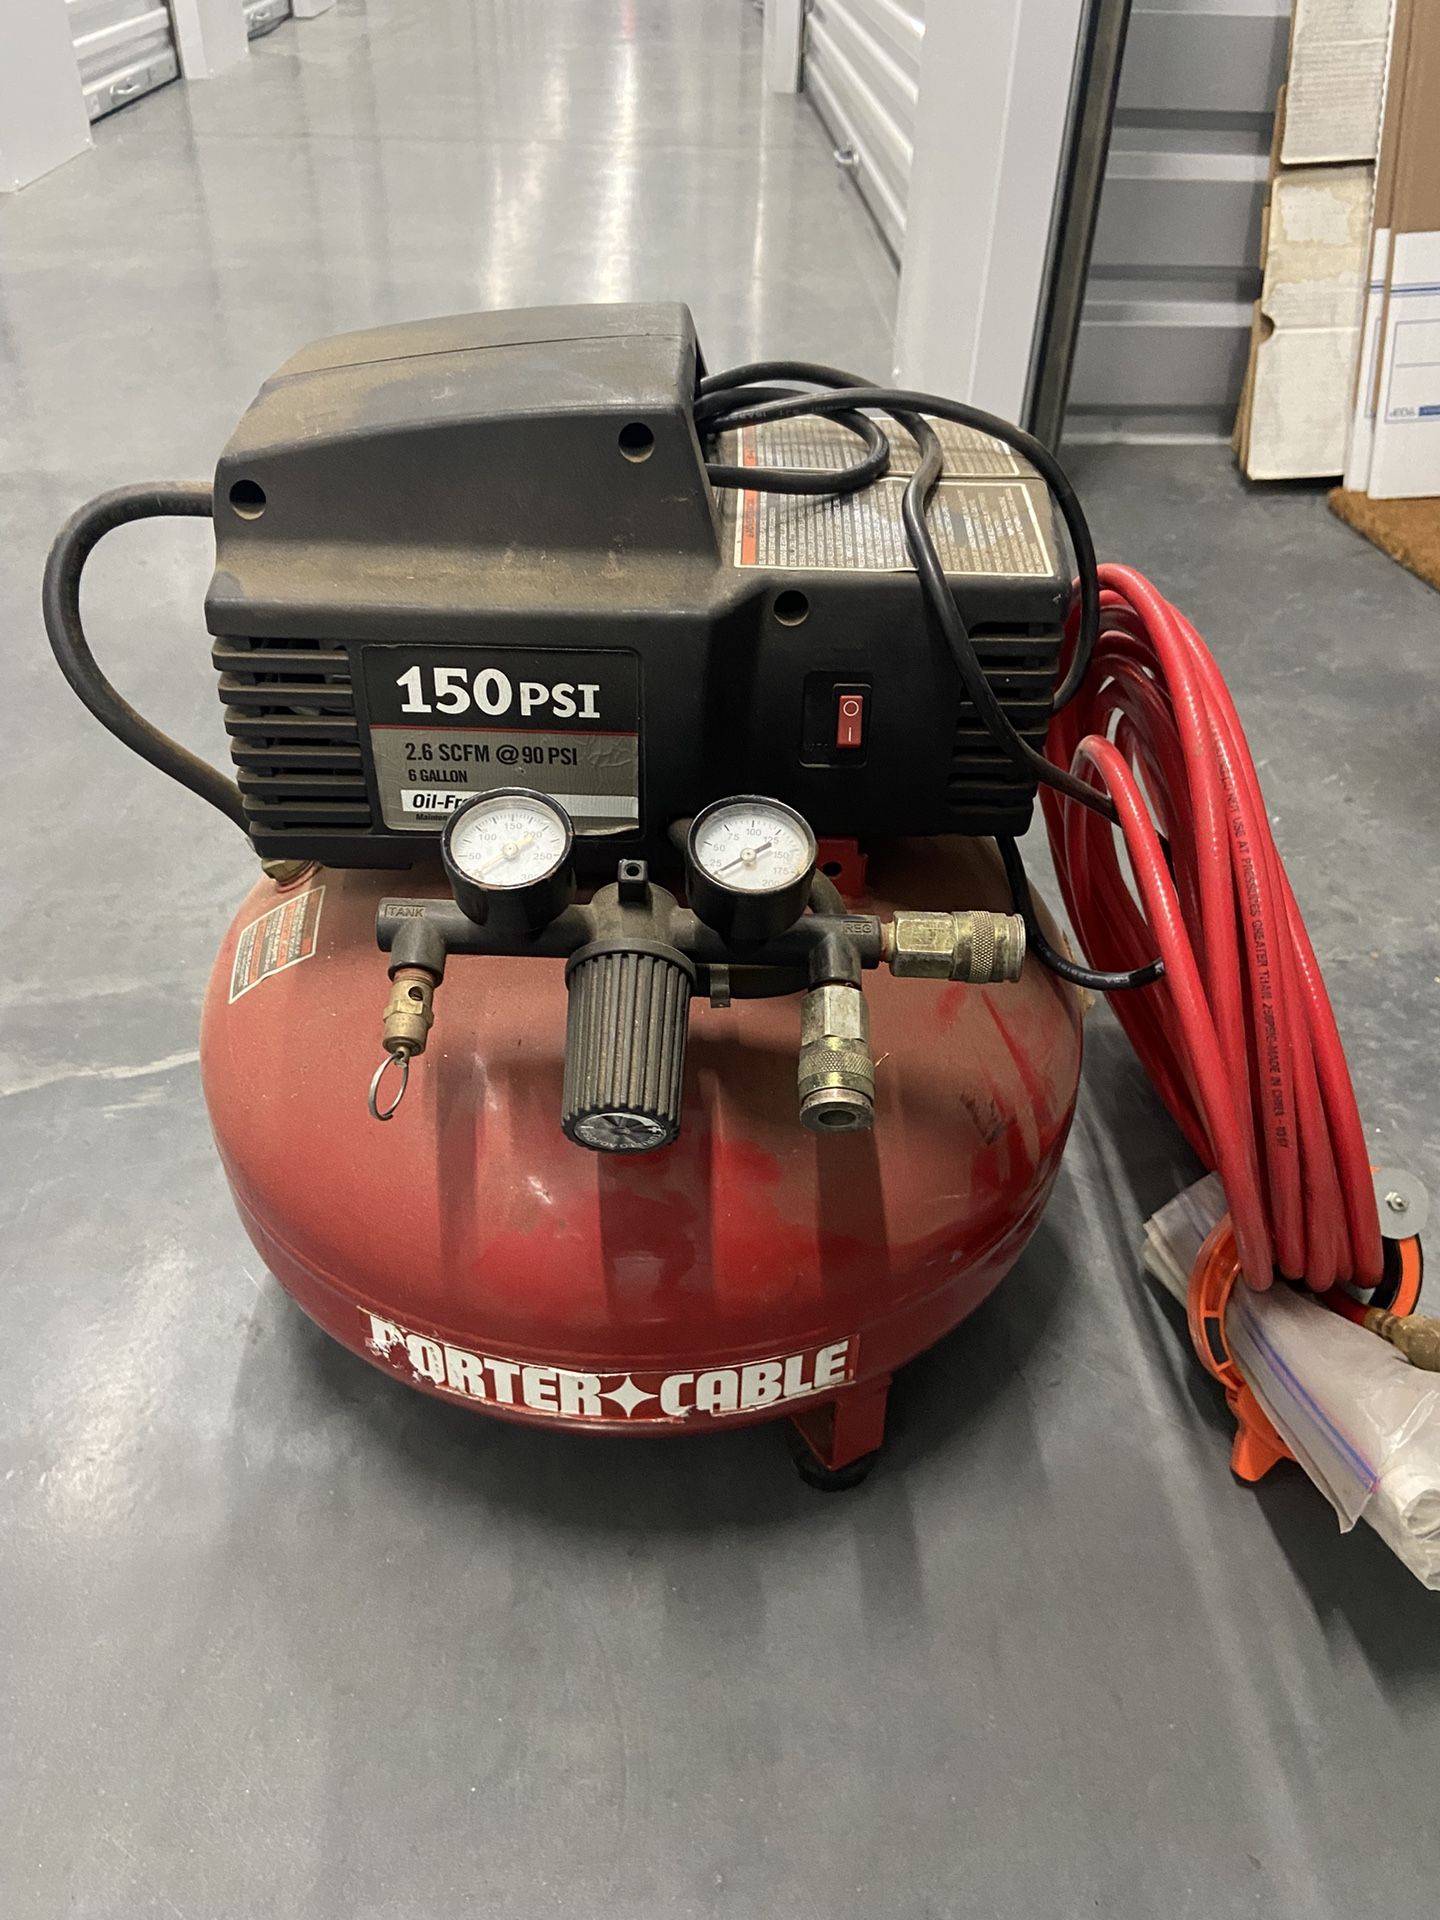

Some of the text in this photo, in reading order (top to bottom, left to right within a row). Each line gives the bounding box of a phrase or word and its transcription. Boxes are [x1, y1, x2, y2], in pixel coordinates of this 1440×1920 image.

[396, 665, 600, 719] 150 PSI
[405, 743, 577, 765] 2.6 SCFM @ 90 PSI
[408, 769, 468, 783] 6 GALLON
[504, 822, 523, 830] 150
[746, 827, 762, 837] 100
[1232, 815, 1247, 837] USE
[479, 833, 497, 841] 100
[728, 832, 740, 841] 75
[713, 844, 790, 859] 50 150
[1237, 840, 1250, 856] AT
[468, 852, 553, 861] 50 250
[710, 859, 790, 875] 25 175
[388, 906, 425, 918] TANK
[844, 923, 873, 934] REG
[659, 1340, 850, 1416] CABLE
